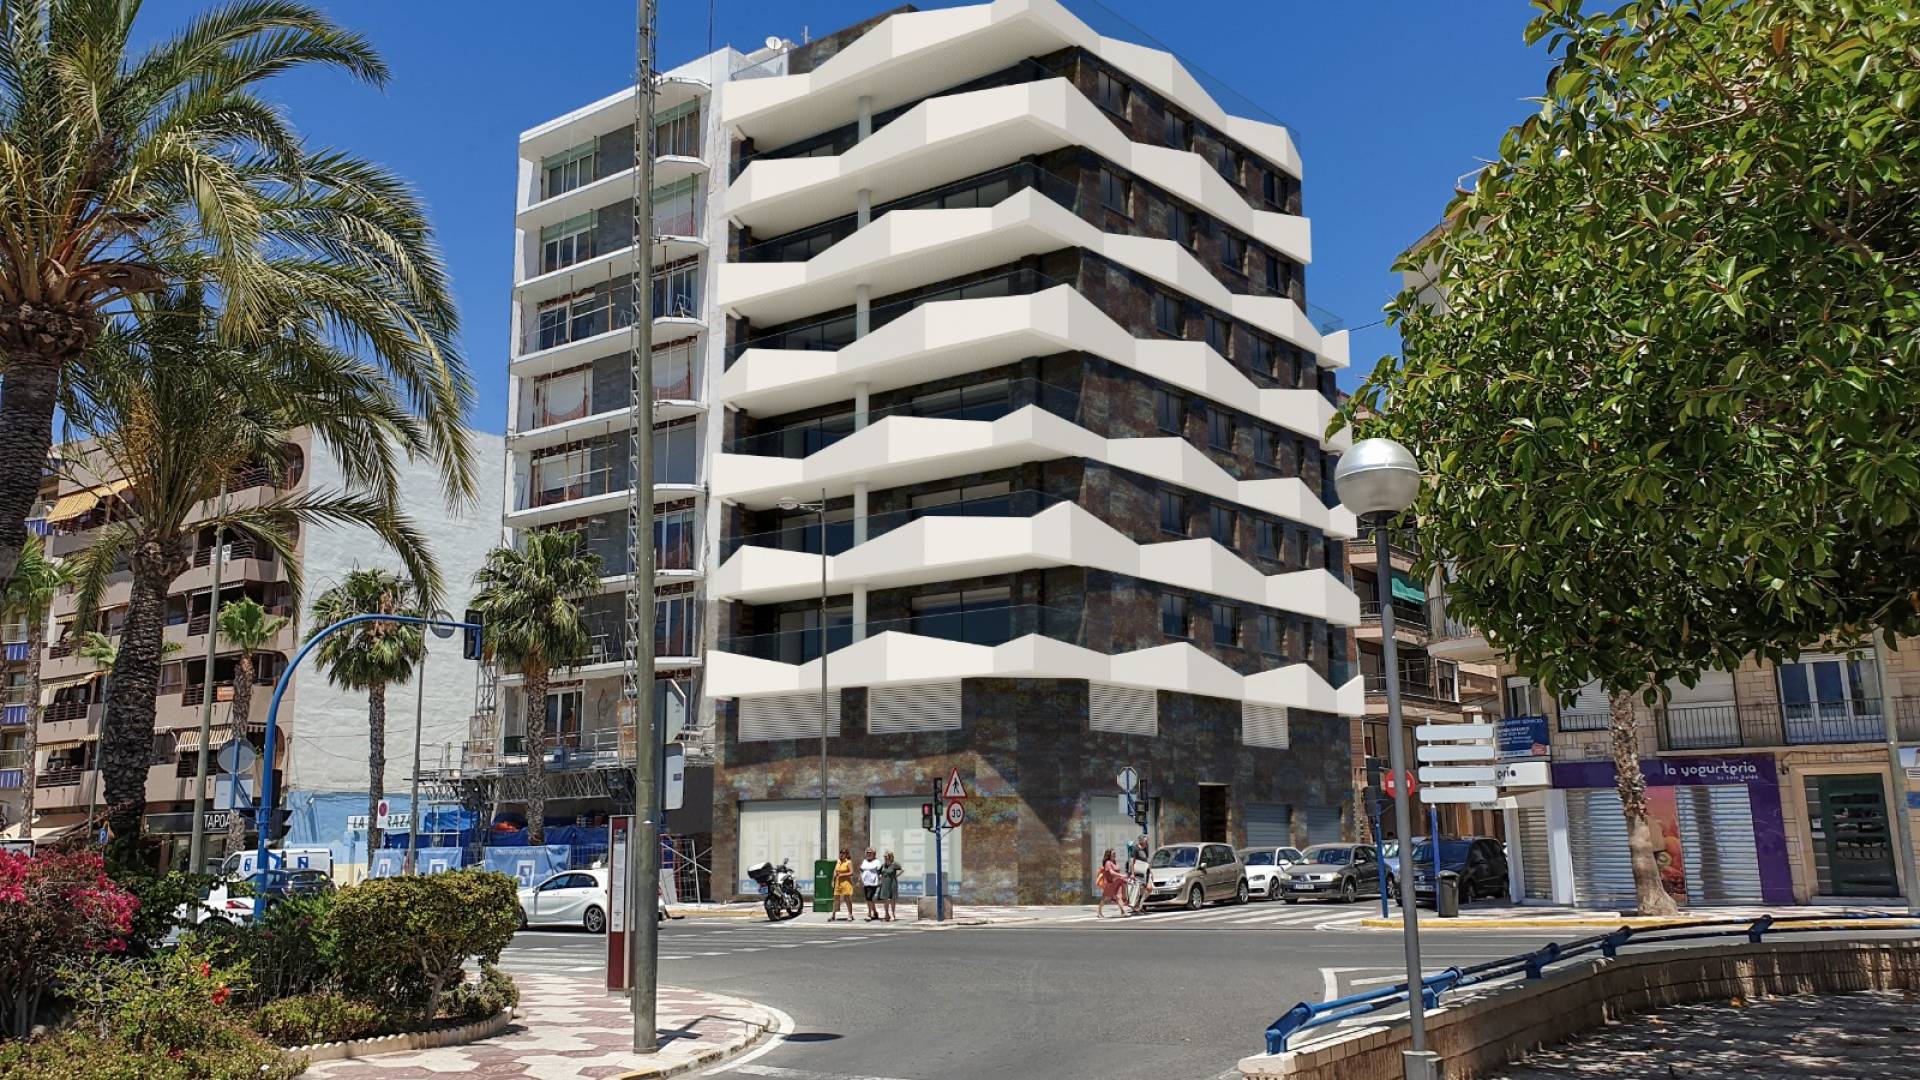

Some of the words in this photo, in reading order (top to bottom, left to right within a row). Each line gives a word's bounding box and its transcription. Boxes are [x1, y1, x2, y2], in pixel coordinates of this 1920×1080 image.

[1663, 763, 1677, 775] la
[951, 808, 962, 818] 30
[353, 816, 365, 829] LA
